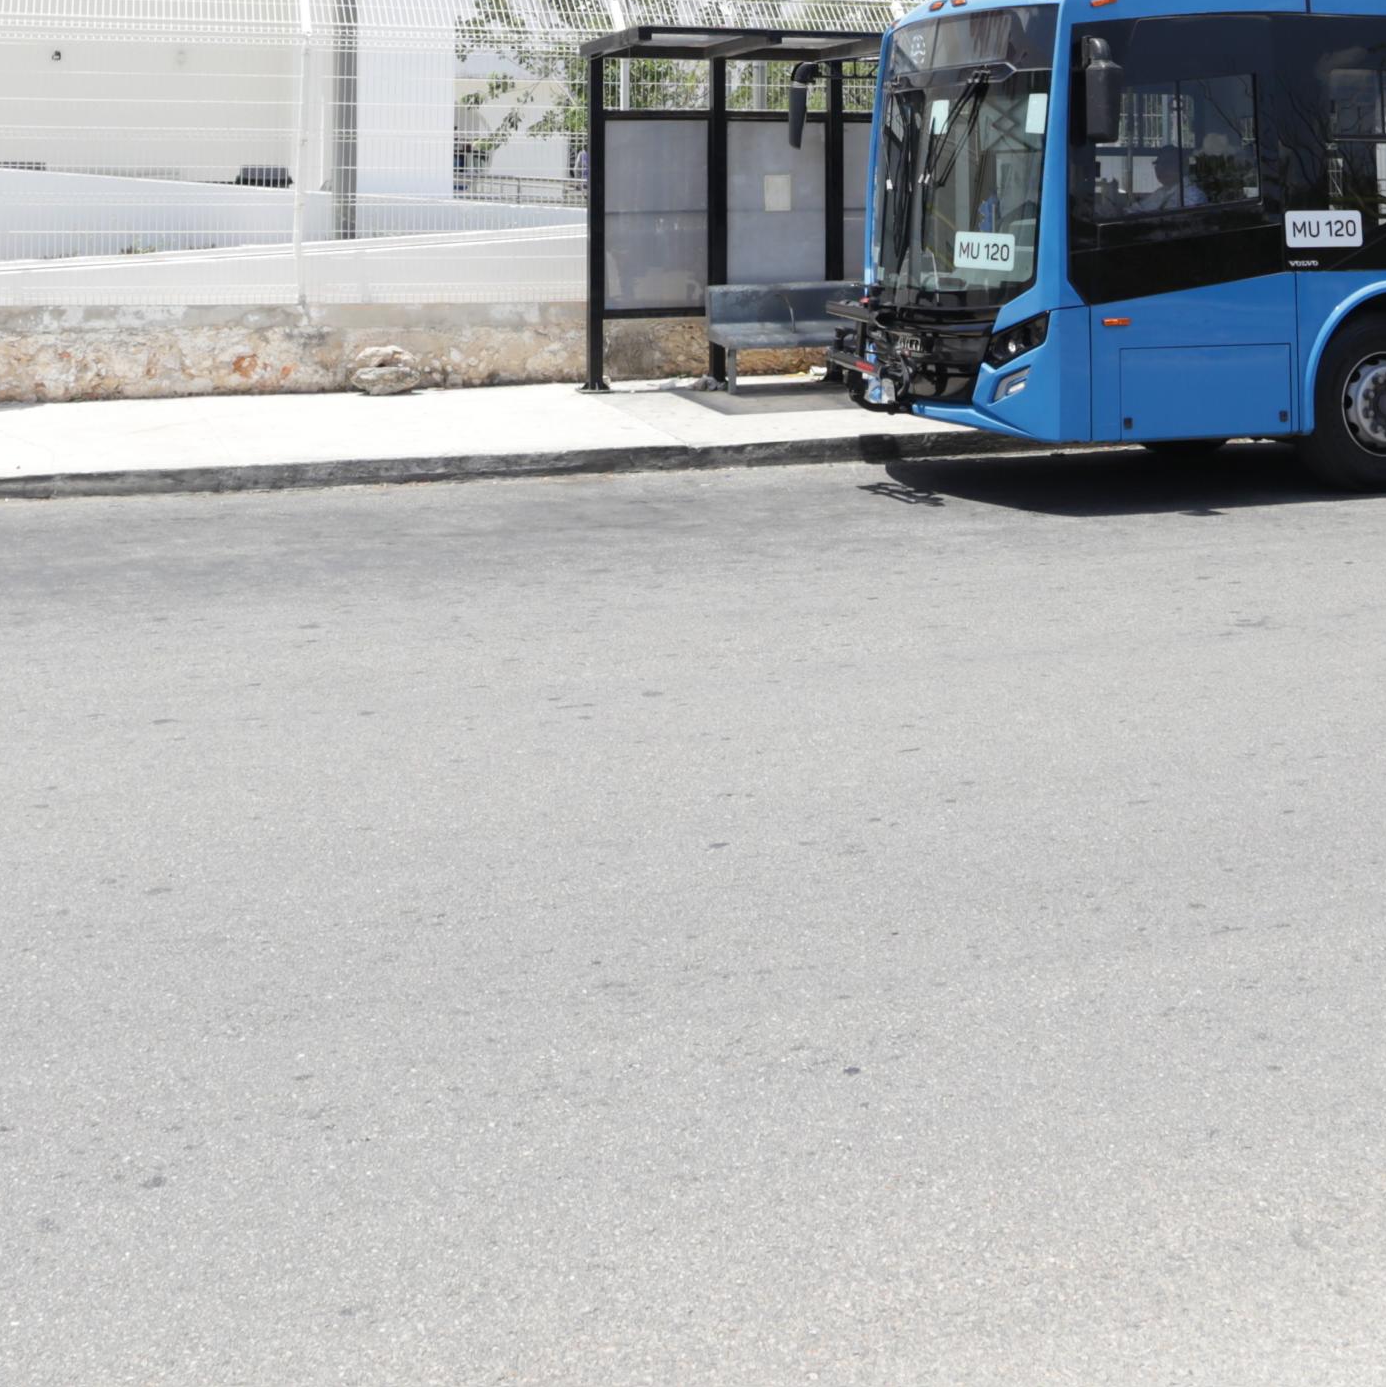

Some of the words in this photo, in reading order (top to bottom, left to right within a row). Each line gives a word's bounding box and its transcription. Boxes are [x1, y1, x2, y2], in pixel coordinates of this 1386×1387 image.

[1292, 220, 1320, 238] MU
[1325, 219, 1357, 237] 120
[958, 241, 980, 260] MU
[984, 243, 1010, 262] 120
